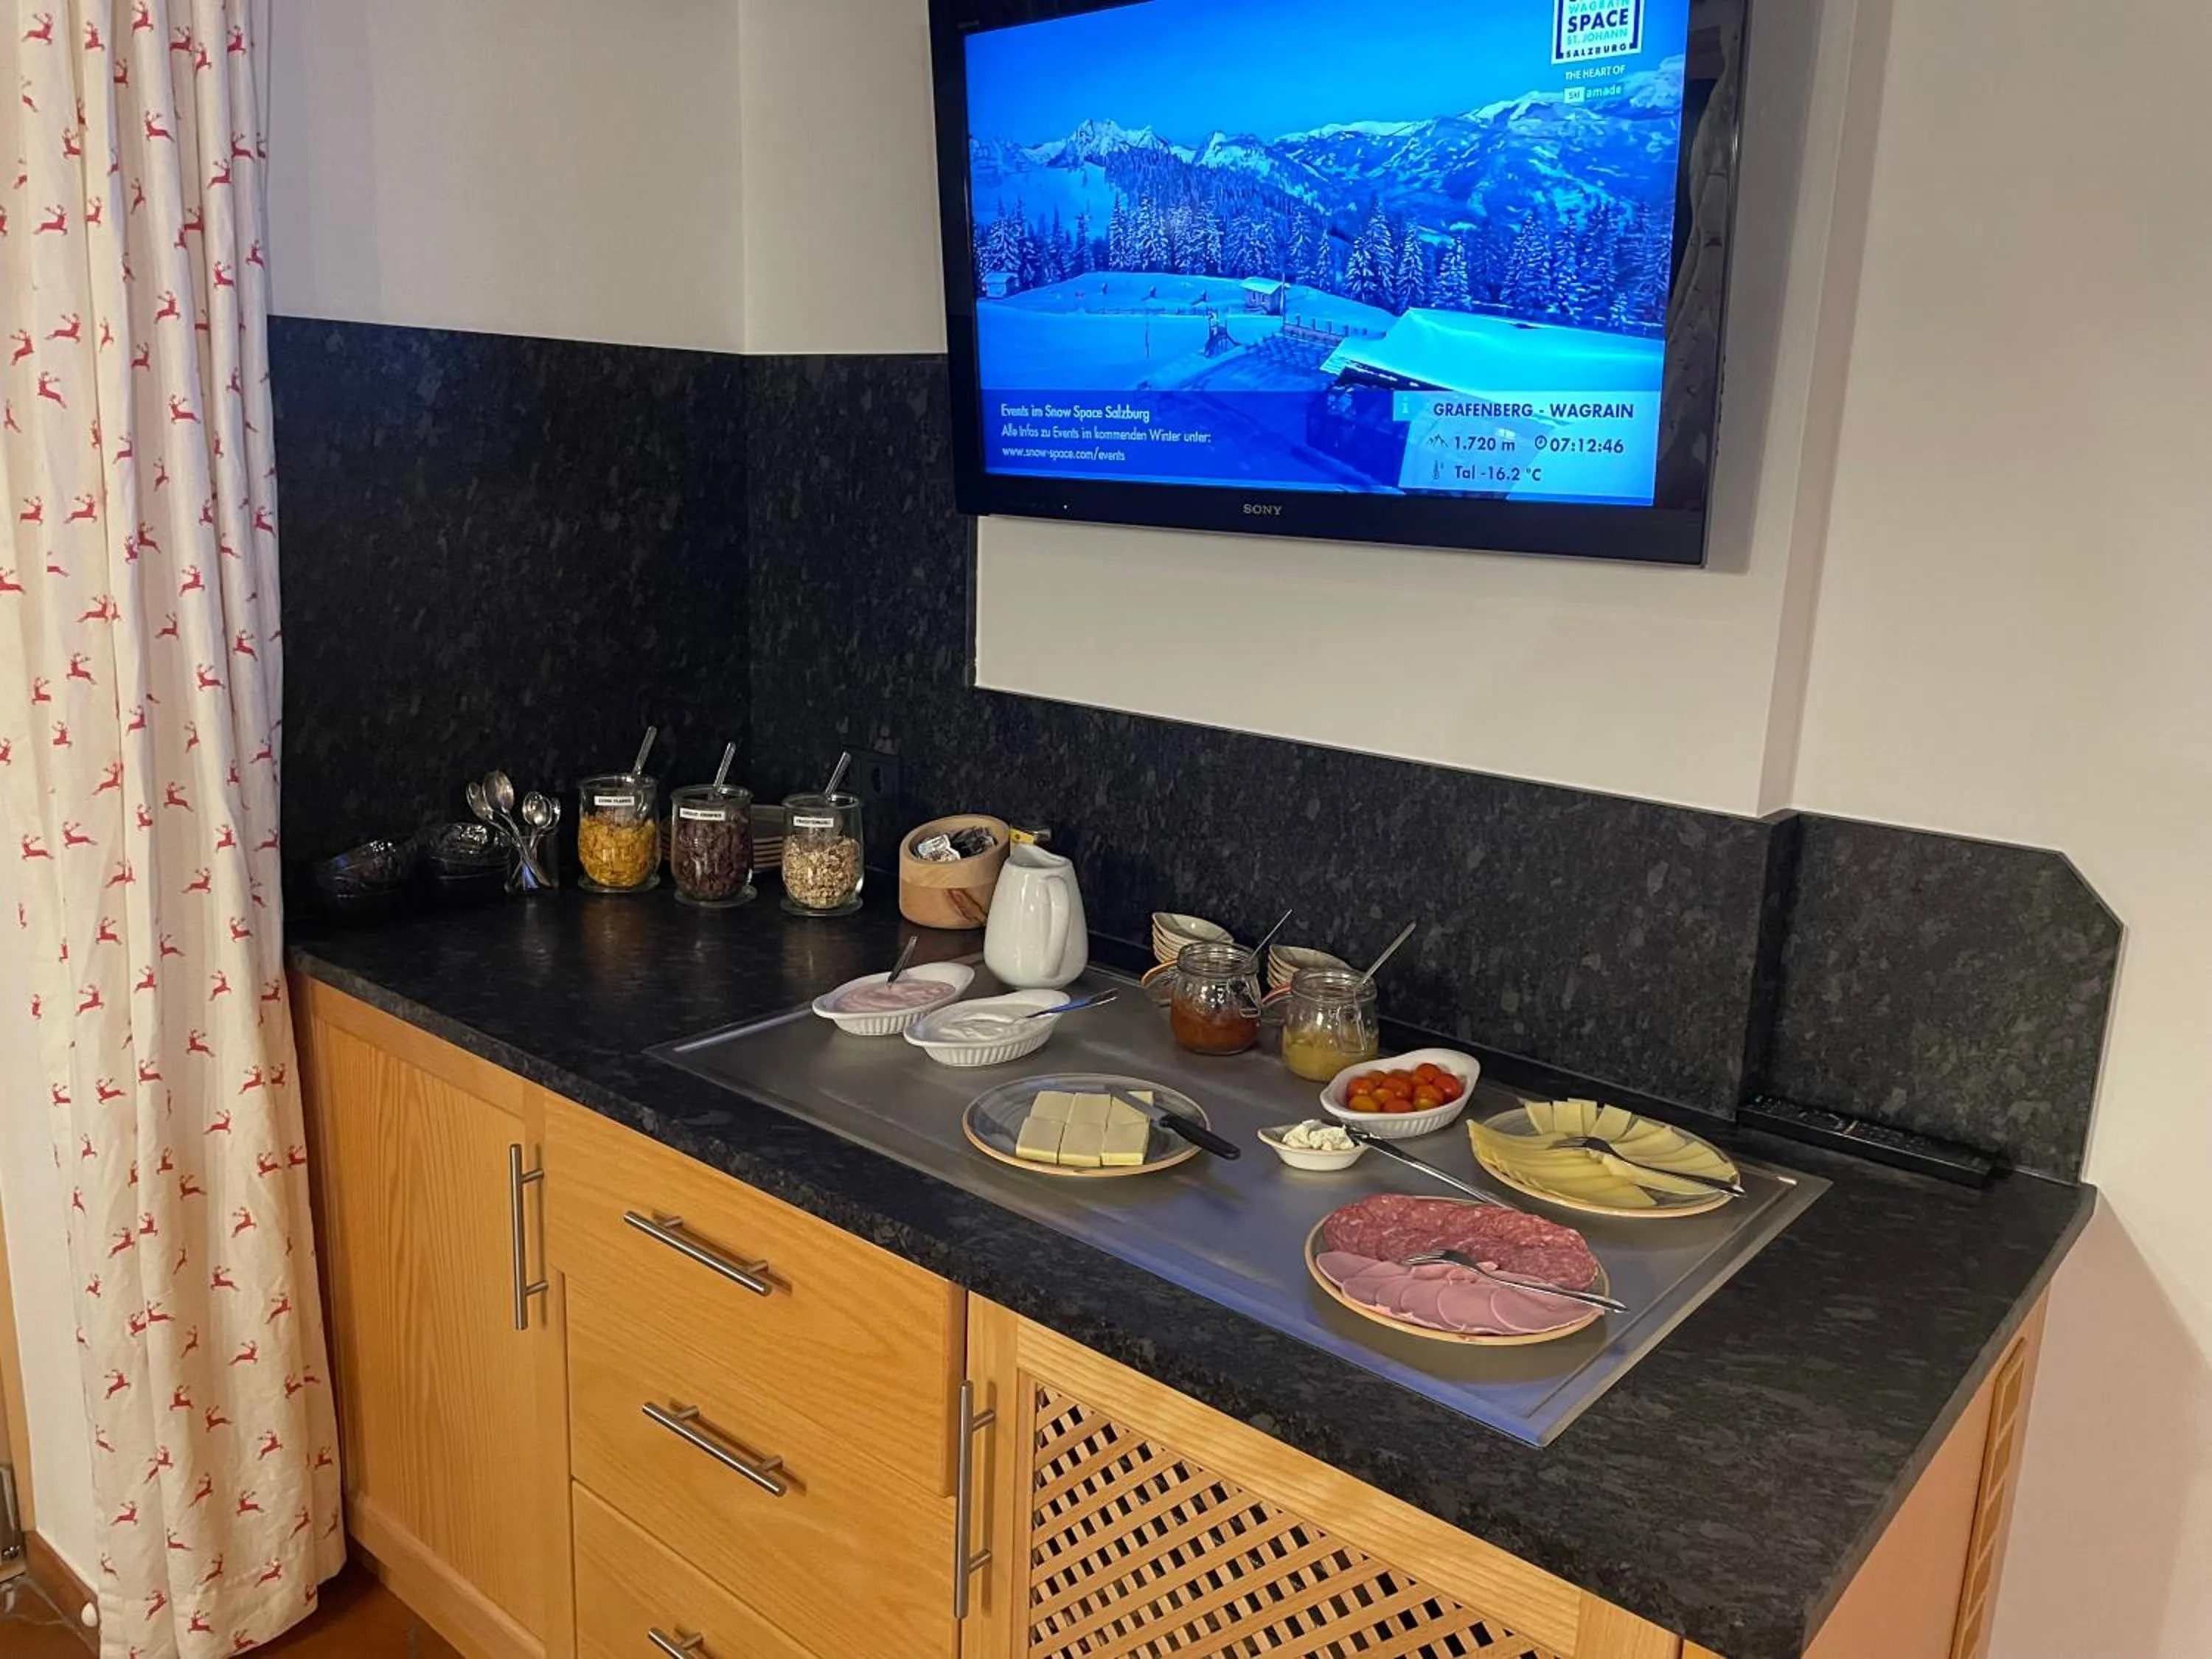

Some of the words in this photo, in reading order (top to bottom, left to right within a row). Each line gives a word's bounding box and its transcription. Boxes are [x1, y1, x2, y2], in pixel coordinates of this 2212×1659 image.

[1568, 8, 1629, 33] SPACE
[1582, 27, 1628, 43] JOHANN
[1566, 43, 1627, 58] SALZBURG
[1565, 70, 1582, 80] THE
[1583, 66, 1611, 79] HEART
[1613, 64, 1626, 74] OF
[1001, 403, 1029, 417] Events
[1031, 405, 1043, 417] im
[1045, 405, 1071, 418] Snow
[1073, 405, 1103, 422] Space
[1105, 404, 1150, 423] Salzburg
[1433, 403, 1533, 417] GRAFENBERG
[1550, 403, 1634, 418] WAGRAIN
[1001, 422, 1018, 437] Alle
[1018, 423, 1039, 437] Infos
[1040, 429, 1051, 437] zu
[1052, 425, 1079, 439] Events
[1082, 428, 1092, 439] im
[1093, 425, 1147, 440] kommenden
[1149, 428, 1181, 442] Winter
[1454, 436, 1496, 451] 1.720
[1501, 440, 1515, 451] m
[1550, 439, 1624, 453] 07:12:46
[1455, 465, 1475, 479] Tal
[1480, 467, 1520, 481] -16.2
[1242, 503, 1282, 515] SONY
